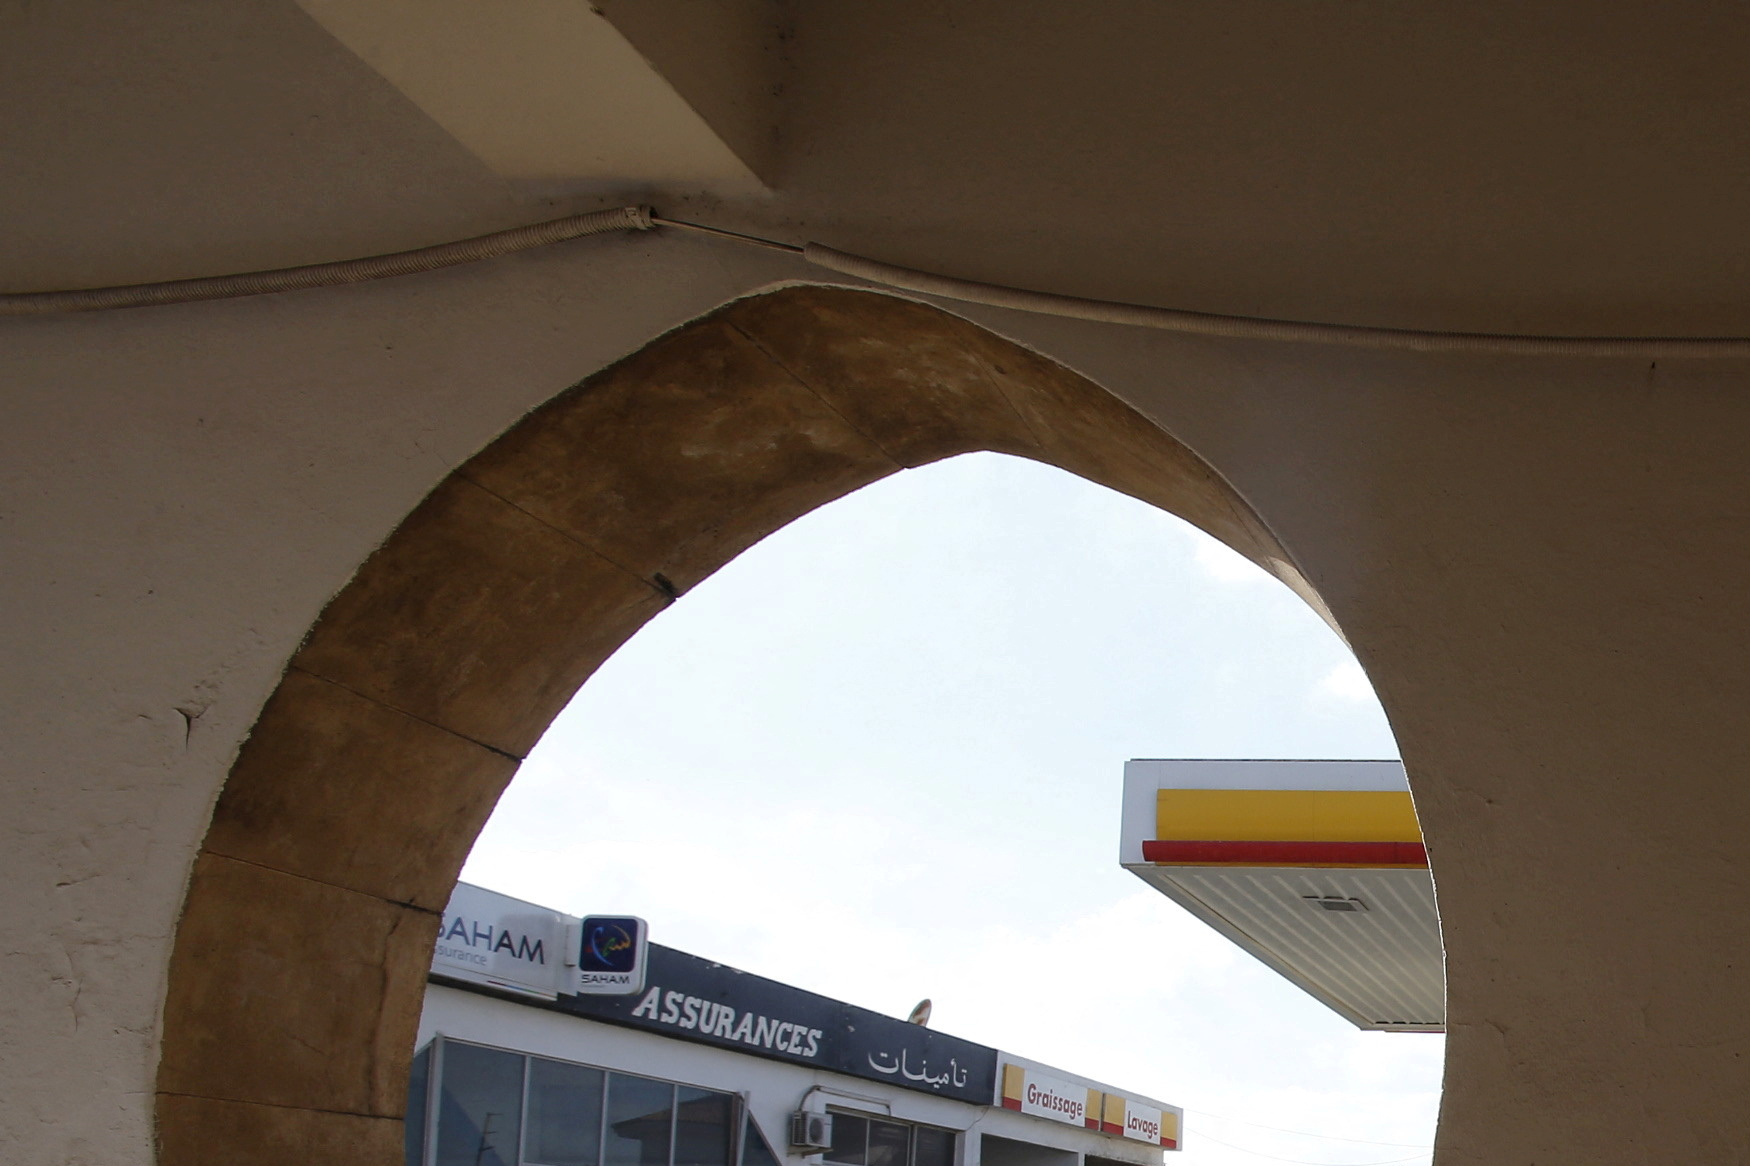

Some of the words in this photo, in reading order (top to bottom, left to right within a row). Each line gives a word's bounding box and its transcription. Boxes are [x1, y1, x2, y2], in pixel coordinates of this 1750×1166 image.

[581, 974, 630, 984] SAHAM
[631, 986, 823, 1058] ASSURANCES
[868, 1048, 968, 1088] تأمينات
[1027, 1083, 1083, 1120] Graissage
[1127, 1110, 1159, 1140] Lavage
